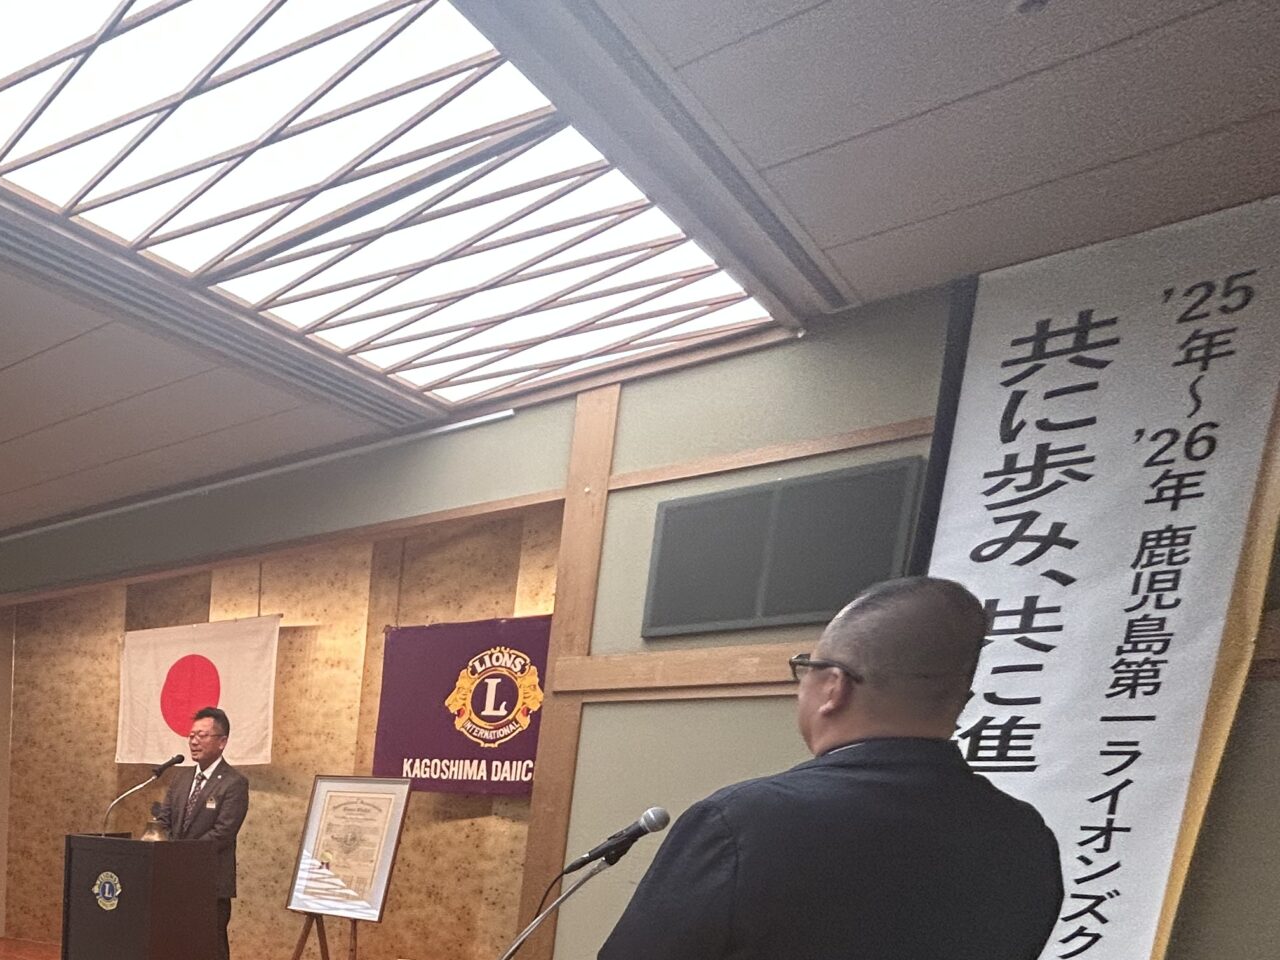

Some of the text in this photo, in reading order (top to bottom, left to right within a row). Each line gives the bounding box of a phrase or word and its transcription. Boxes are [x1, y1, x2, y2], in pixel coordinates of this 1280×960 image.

[472, 652, 525, 673] LIONS
[481, 678, 508, 717] L
[464, 719, 520, 740] INTERNATIONAL
[402, 758, 535, 781] KAGOSHIMA DAIIC
[104, 883, 113, 898] L
